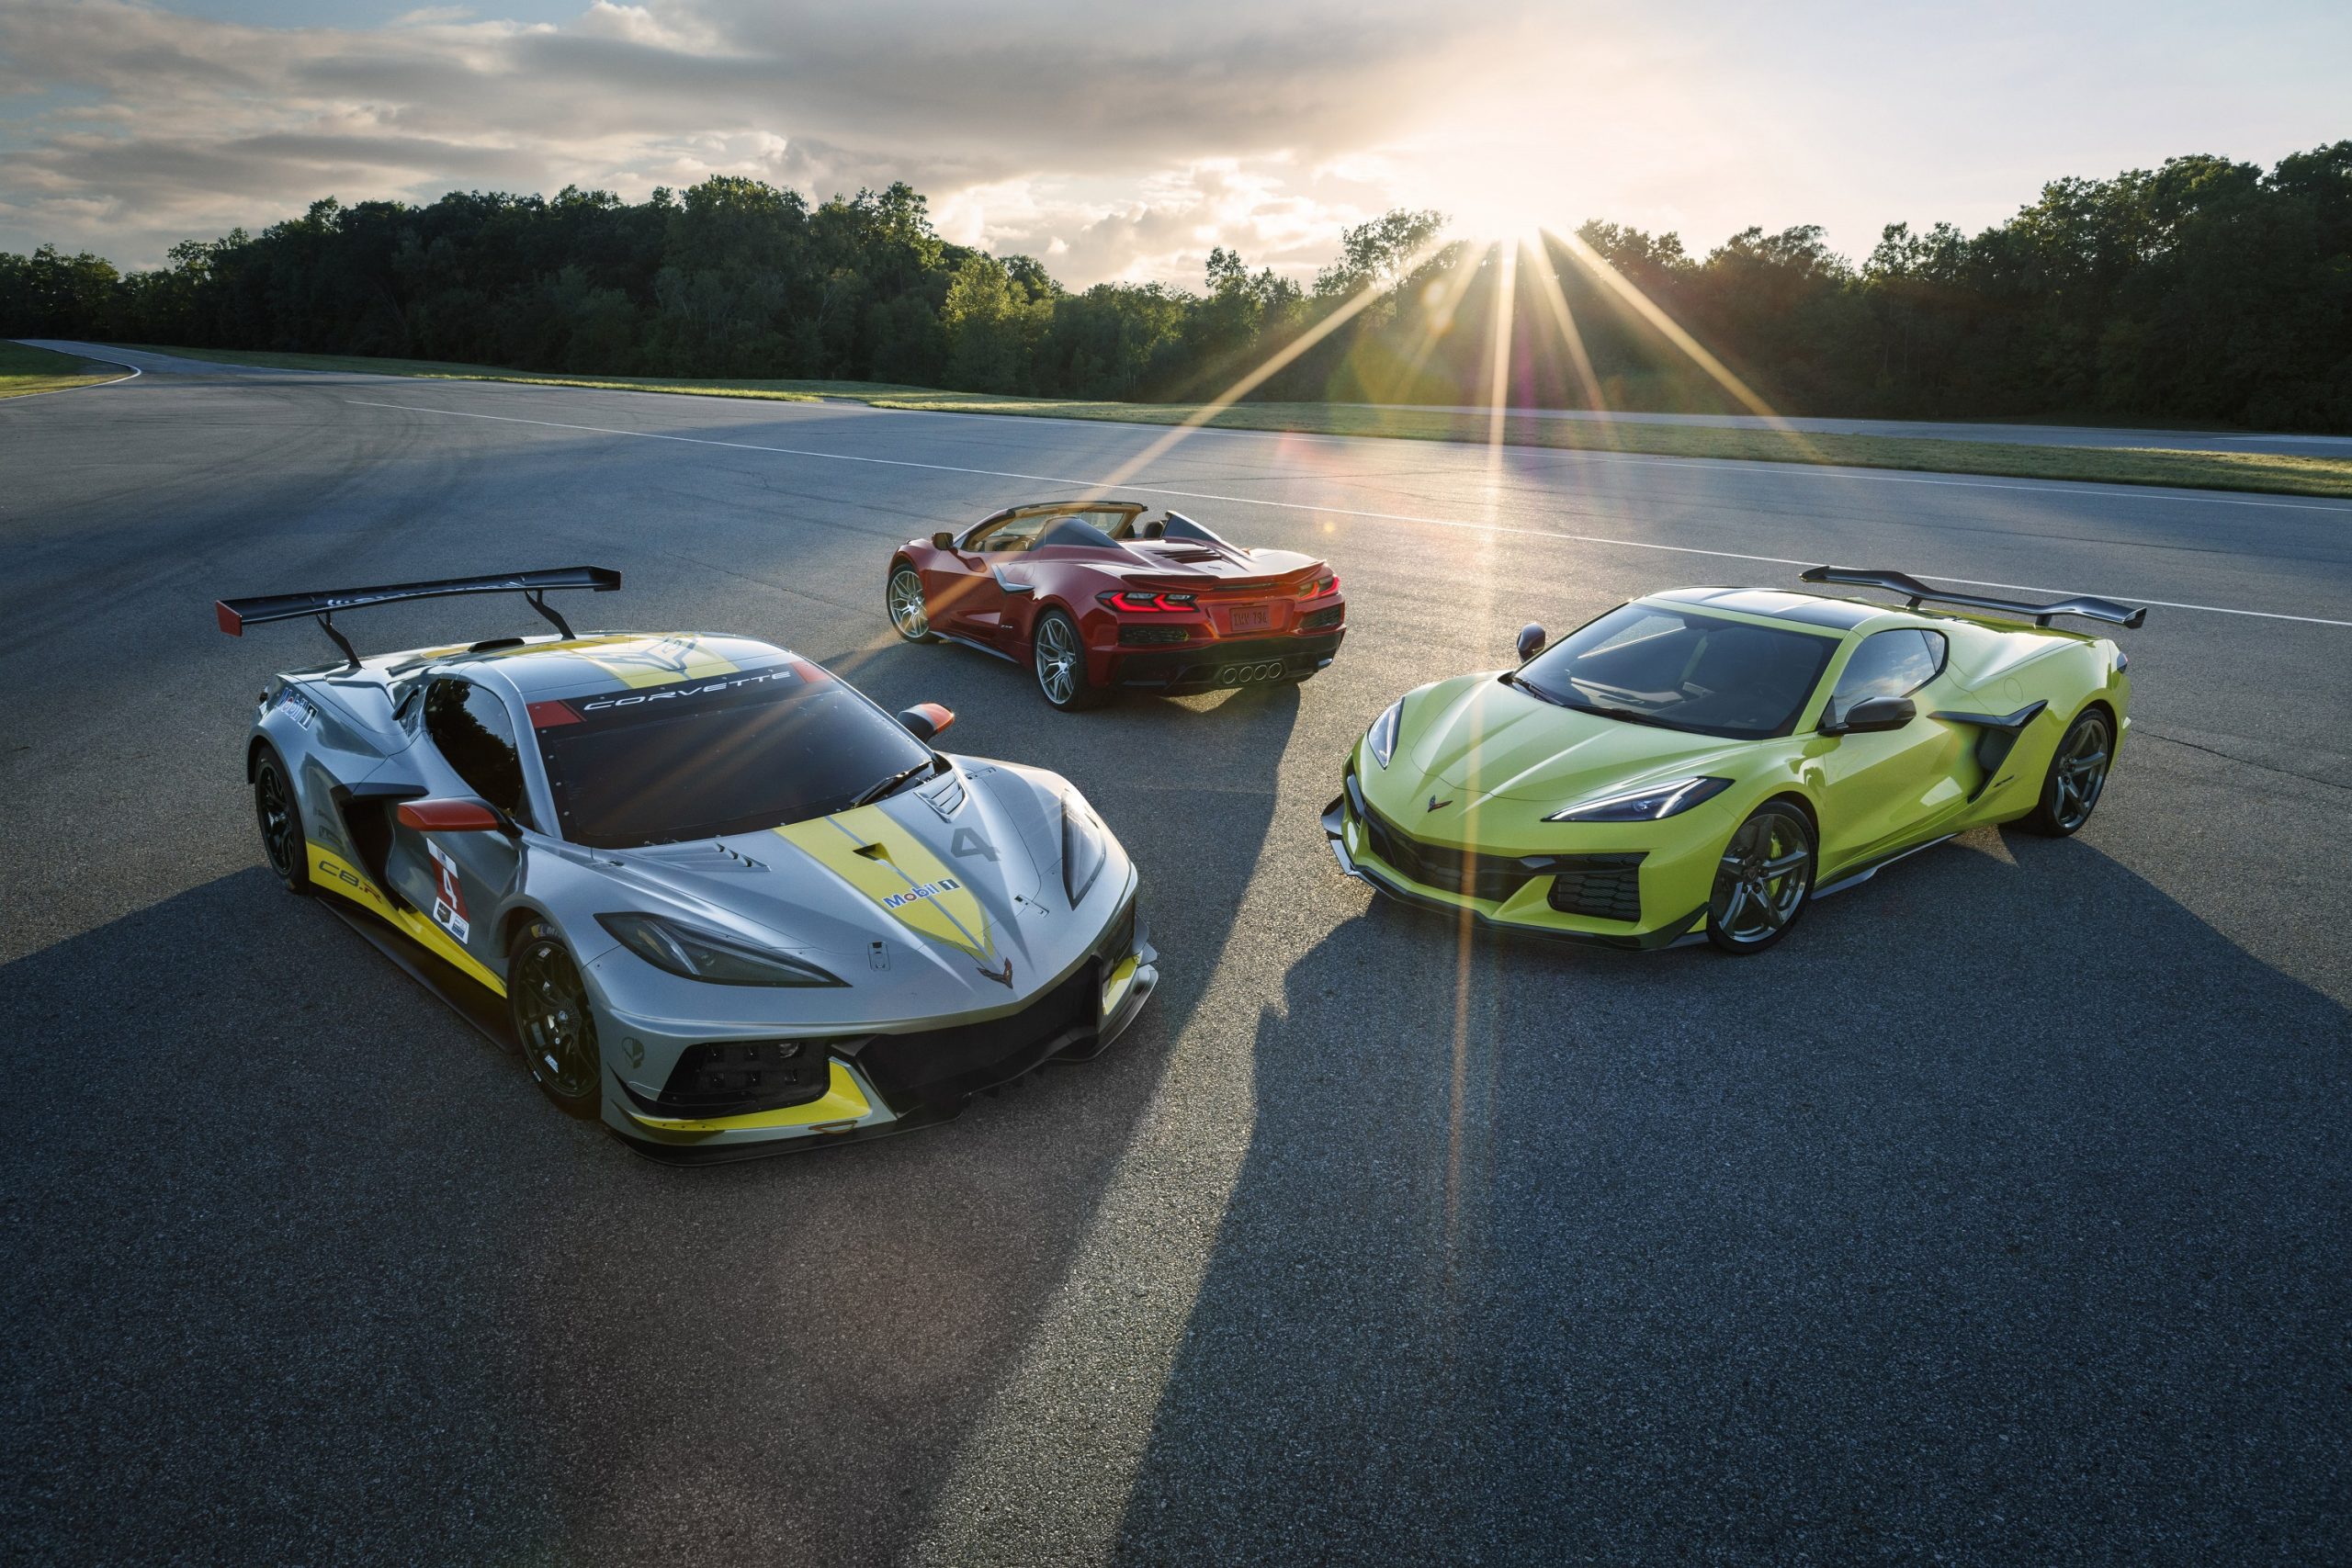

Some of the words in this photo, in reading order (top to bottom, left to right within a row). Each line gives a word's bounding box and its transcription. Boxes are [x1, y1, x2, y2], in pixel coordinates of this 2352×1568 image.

[583, 671, 791, 711] CORVETTE
[951, 828, 1001, 862] 4
[443, 867, 458, 910] 4
[883, 884, 940, 908] Mobil
